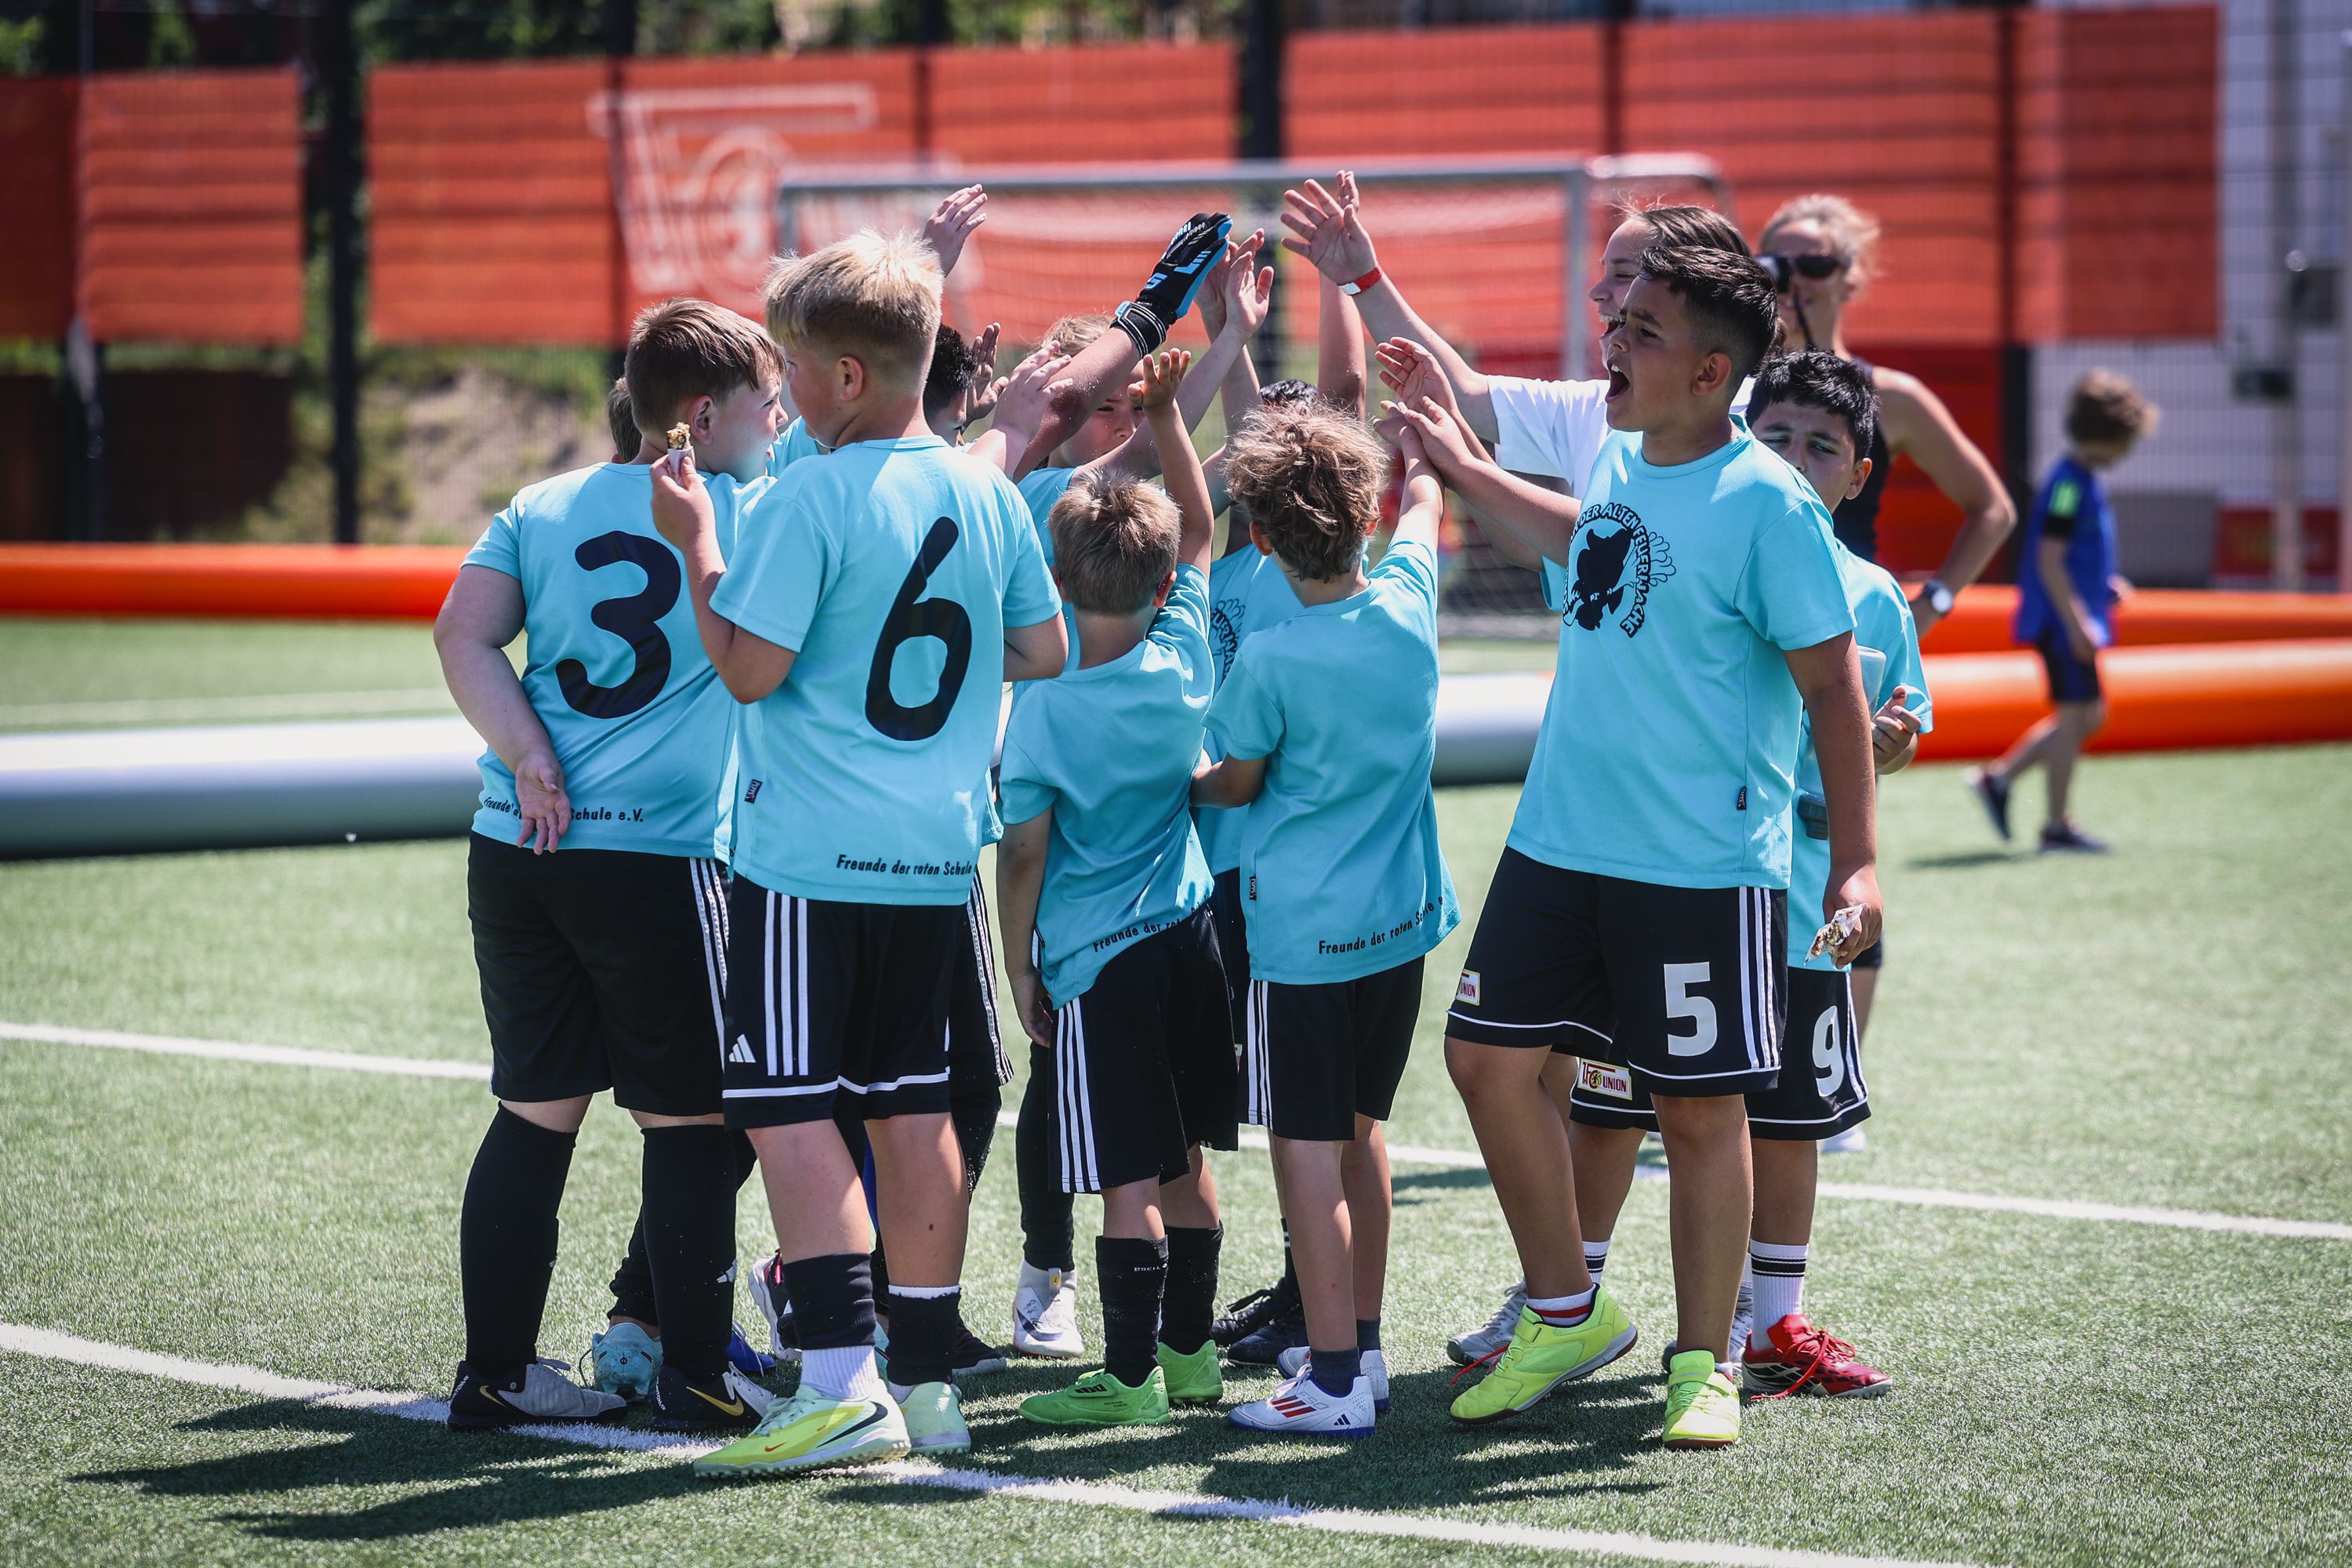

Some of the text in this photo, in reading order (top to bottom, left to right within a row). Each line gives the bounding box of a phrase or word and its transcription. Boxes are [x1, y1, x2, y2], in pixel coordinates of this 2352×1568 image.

[1600, 502, 1642, 531] ALTEN
[1620, 525, 1652, 638] FEUERWACHE
[555, 530, 681, 719] 3
[865, 516, 971, 741] 6
[618, 808, 644, 822] e.V.
[837, 855, 887, 873] Freunde
[891, 859, 909, 874] der
[913, 863, 939, 876] roten
[943, 861, 971, 876] Schule
[1093, 927, 1139, 953] Freunde
[1143, 922, 1161, 934] der
[1319, 937, 1366, 954] Freunde
[1370, 932, 1385, 946] der
[1390, 920, 1413, 938] roten
[1663, 961, 1718, 1056] 5
[1812, 1006, 1844, 1097] 9
[1602, 1076, 1627, 1092] UNION
